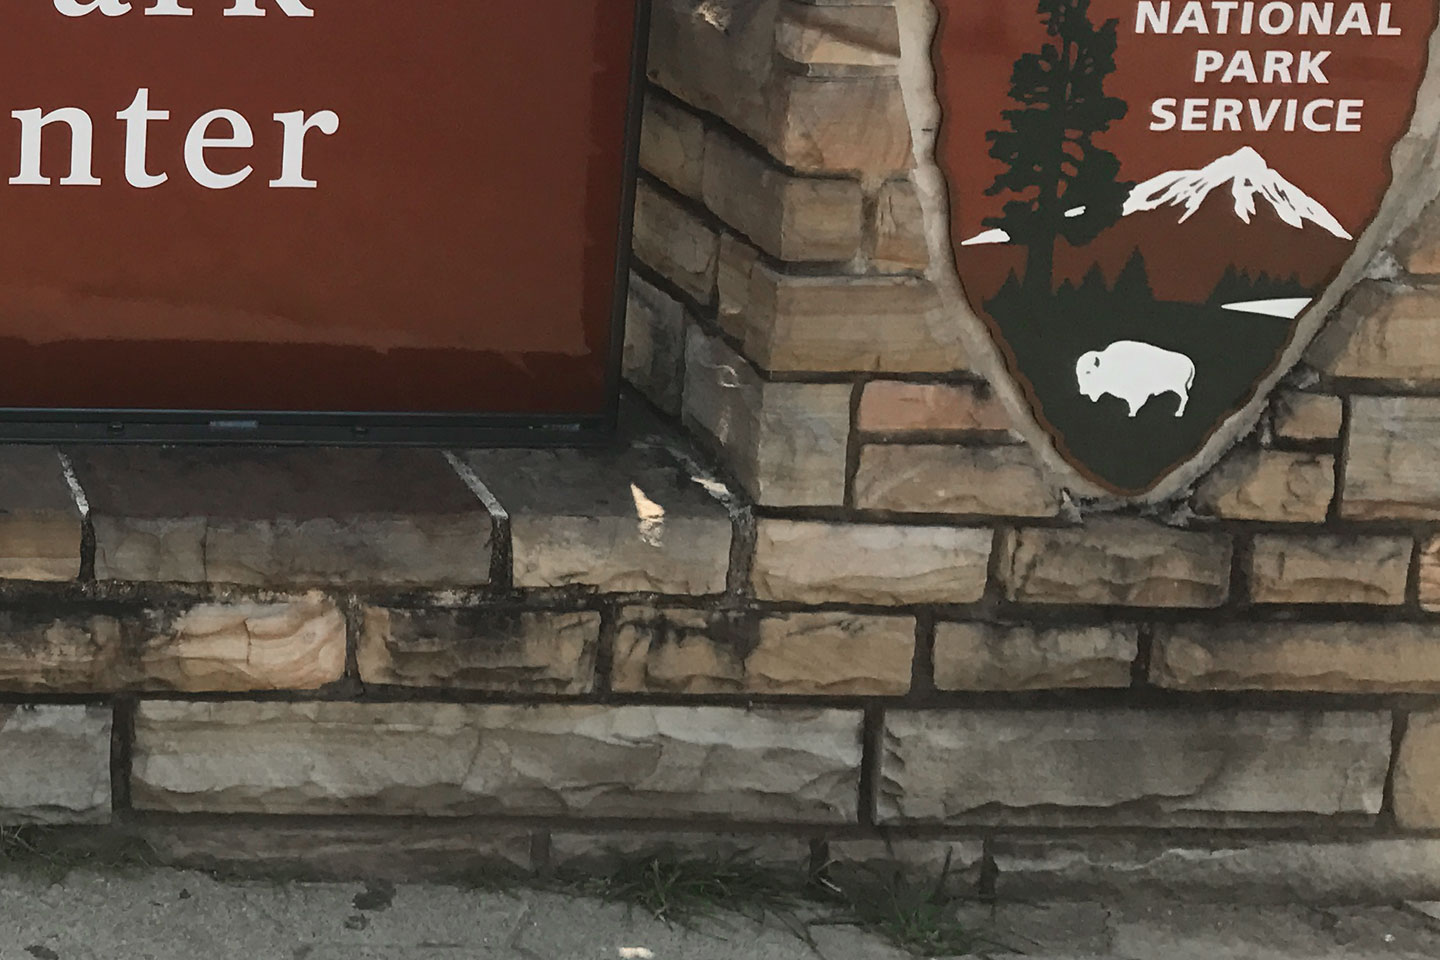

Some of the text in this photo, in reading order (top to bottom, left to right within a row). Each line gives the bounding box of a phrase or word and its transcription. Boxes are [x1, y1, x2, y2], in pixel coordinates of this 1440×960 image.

[1134, 0, 1402, 36] NATIONAL
[1193, 49, 1332, 84] PARK
[1148, 97, 1364, 133] SERVICE
